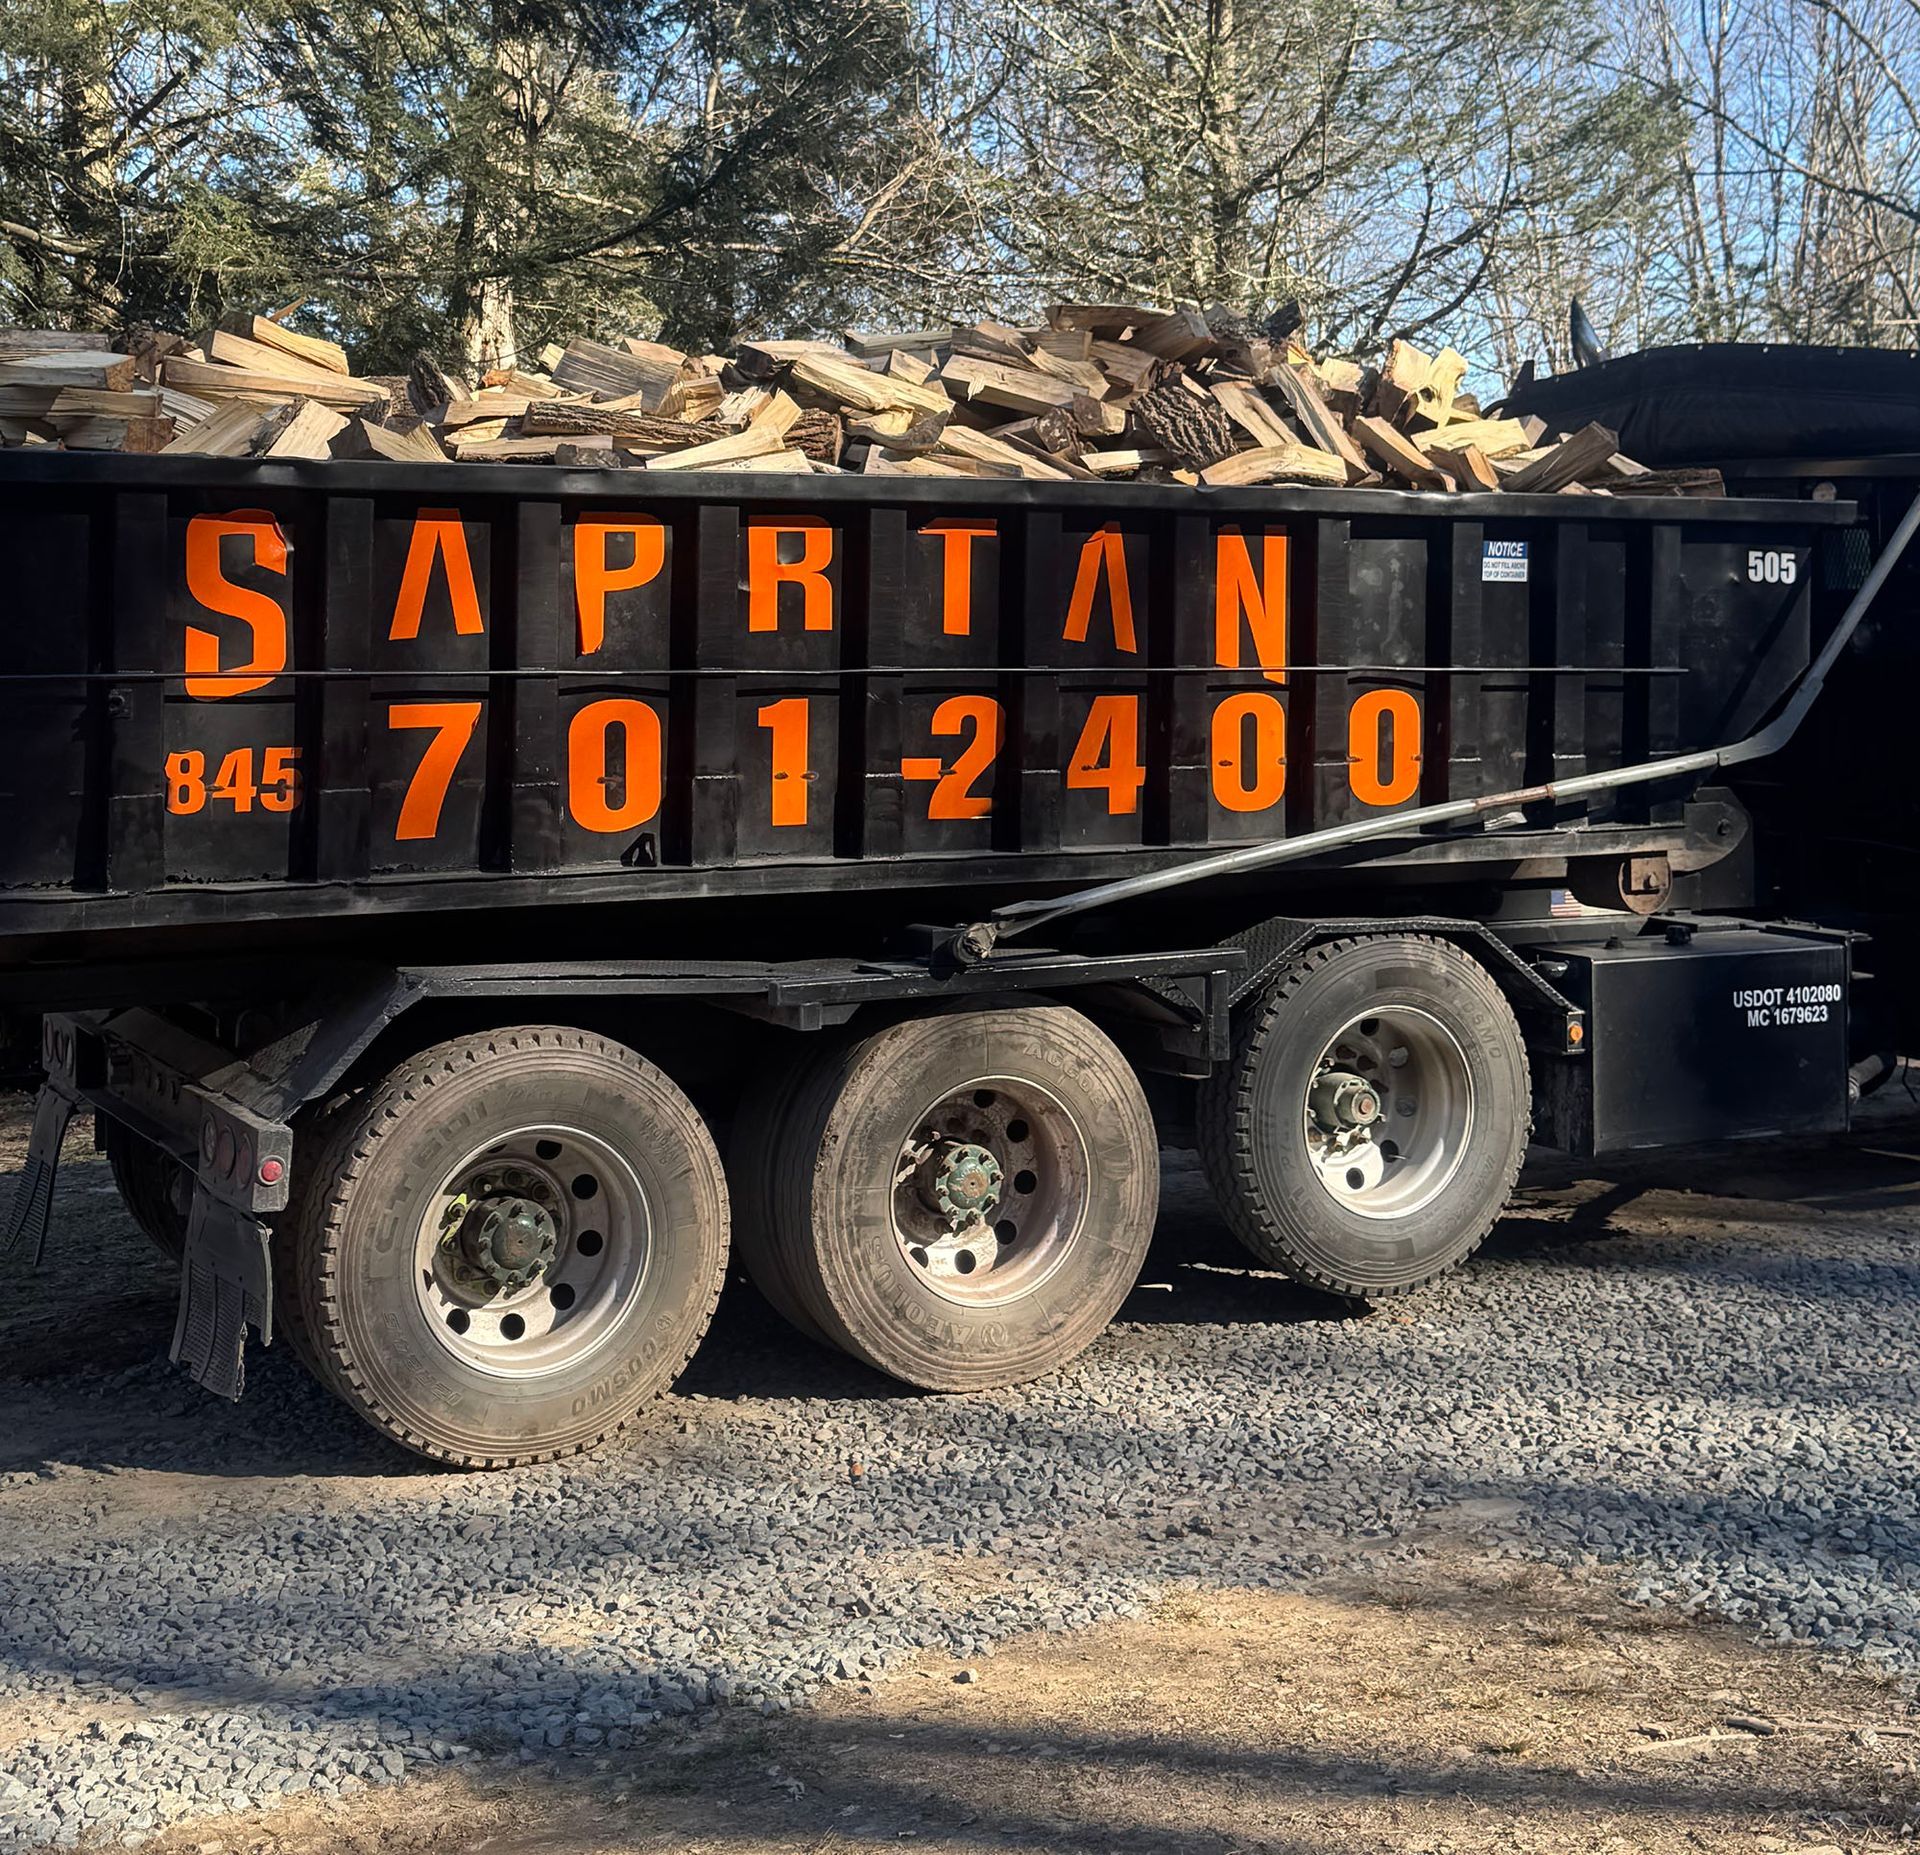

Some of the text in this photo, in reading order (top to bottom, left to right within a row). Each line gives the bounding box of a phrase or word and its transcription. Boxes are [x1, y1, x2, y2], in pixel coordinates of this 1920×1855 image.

[1488, 541, 1524, 557] NOTICE
[1747, 551, 1797, 584] 505
[164, 747, 304, 815] 845
[1733, 984, 1841, 1008] USDOT 4102080
[1747, 1005, 1828, 1027] MC 1679623
[865, 1235, 974, 1347] AEOLUS
[571, 1337, 659, 1417] COSMO
